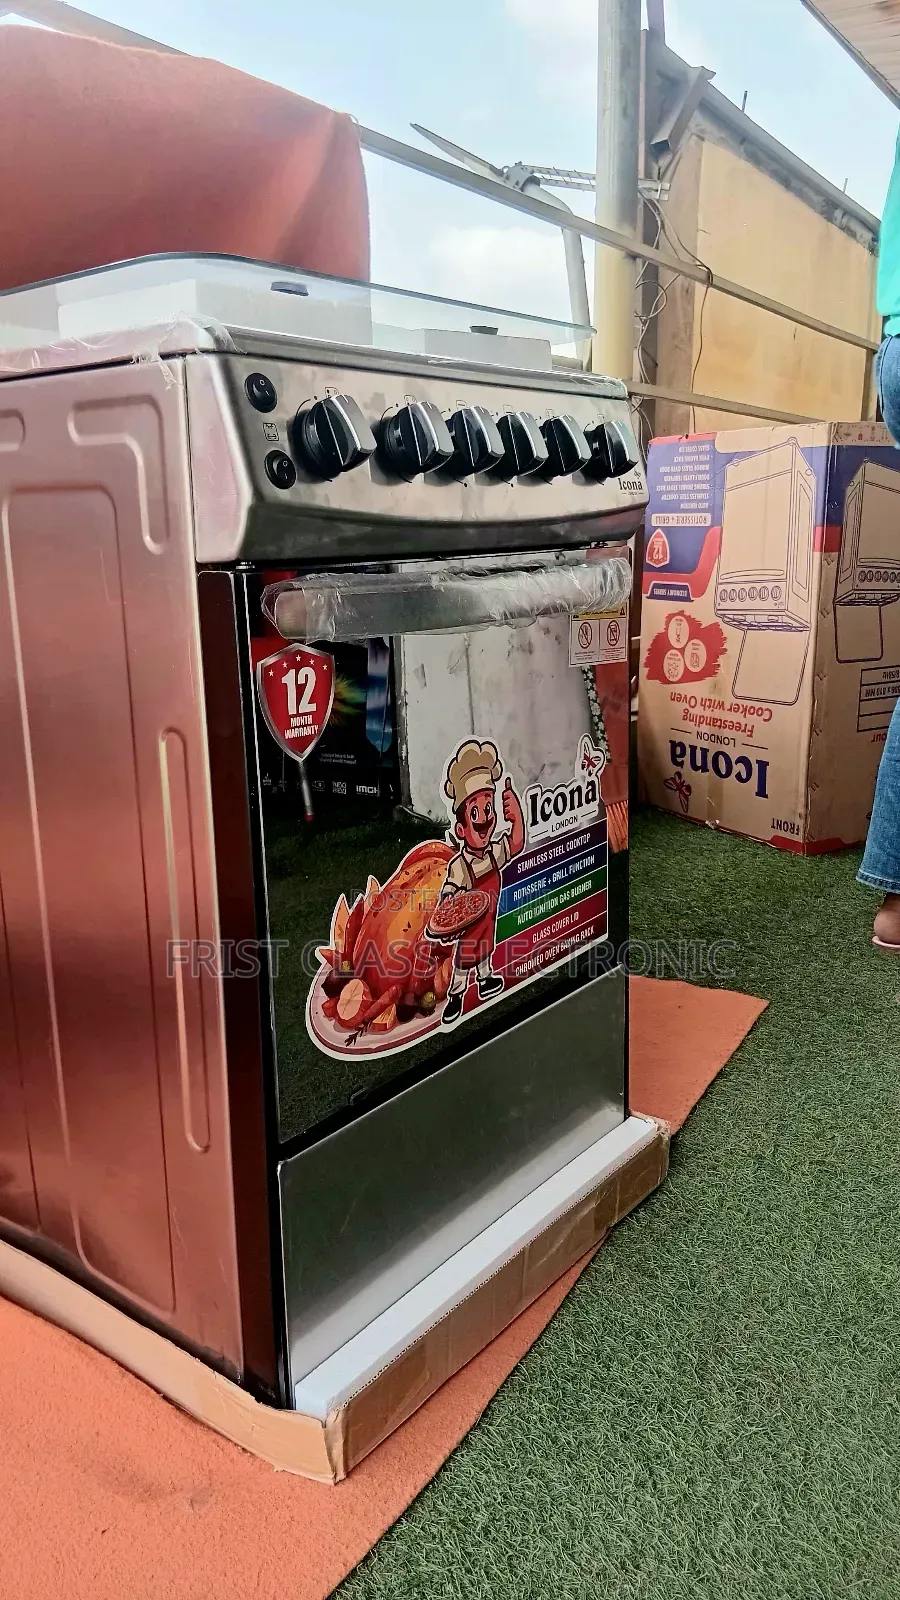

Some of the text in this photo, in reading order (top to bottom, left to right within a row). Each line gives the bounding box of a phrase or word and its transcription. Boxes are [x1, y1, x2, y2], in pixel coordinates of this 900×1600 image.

[618, 478, 643, 490] Icona
[653, 545, 663, 560] 12
[282, 666, 316, 715] 12
[290, 714, 312, 726] MONTH
[670, 691, 772, 722] Cooker with Oven
[285, 725, 318, 739] WARRANTY
[682, 708, 754, 738] Freestanding
[696, 731, 736, 747] LONDON
[669, 740, 769, 799] Icona
[529, 778, 597, 827] Icona
[552, 814, 578, 832] LONDON
[771, 818, 800, 835] FRONT
[517, 832, 590, 874] STAINLESS STEEL COOKTOP
[513, 878, 547, 901] ROTISSERIE
[552, 867, 568, 882] GRILL
[569, 855, 595, 874] FUNCTION
[517, 880, 592, 925] AUTO IGNITION GAS BURNER
[532, 912, 579, 944] GLASS COVER LID
[515, 926, 594, 977] CHROMED OVEN BAKING RACK
